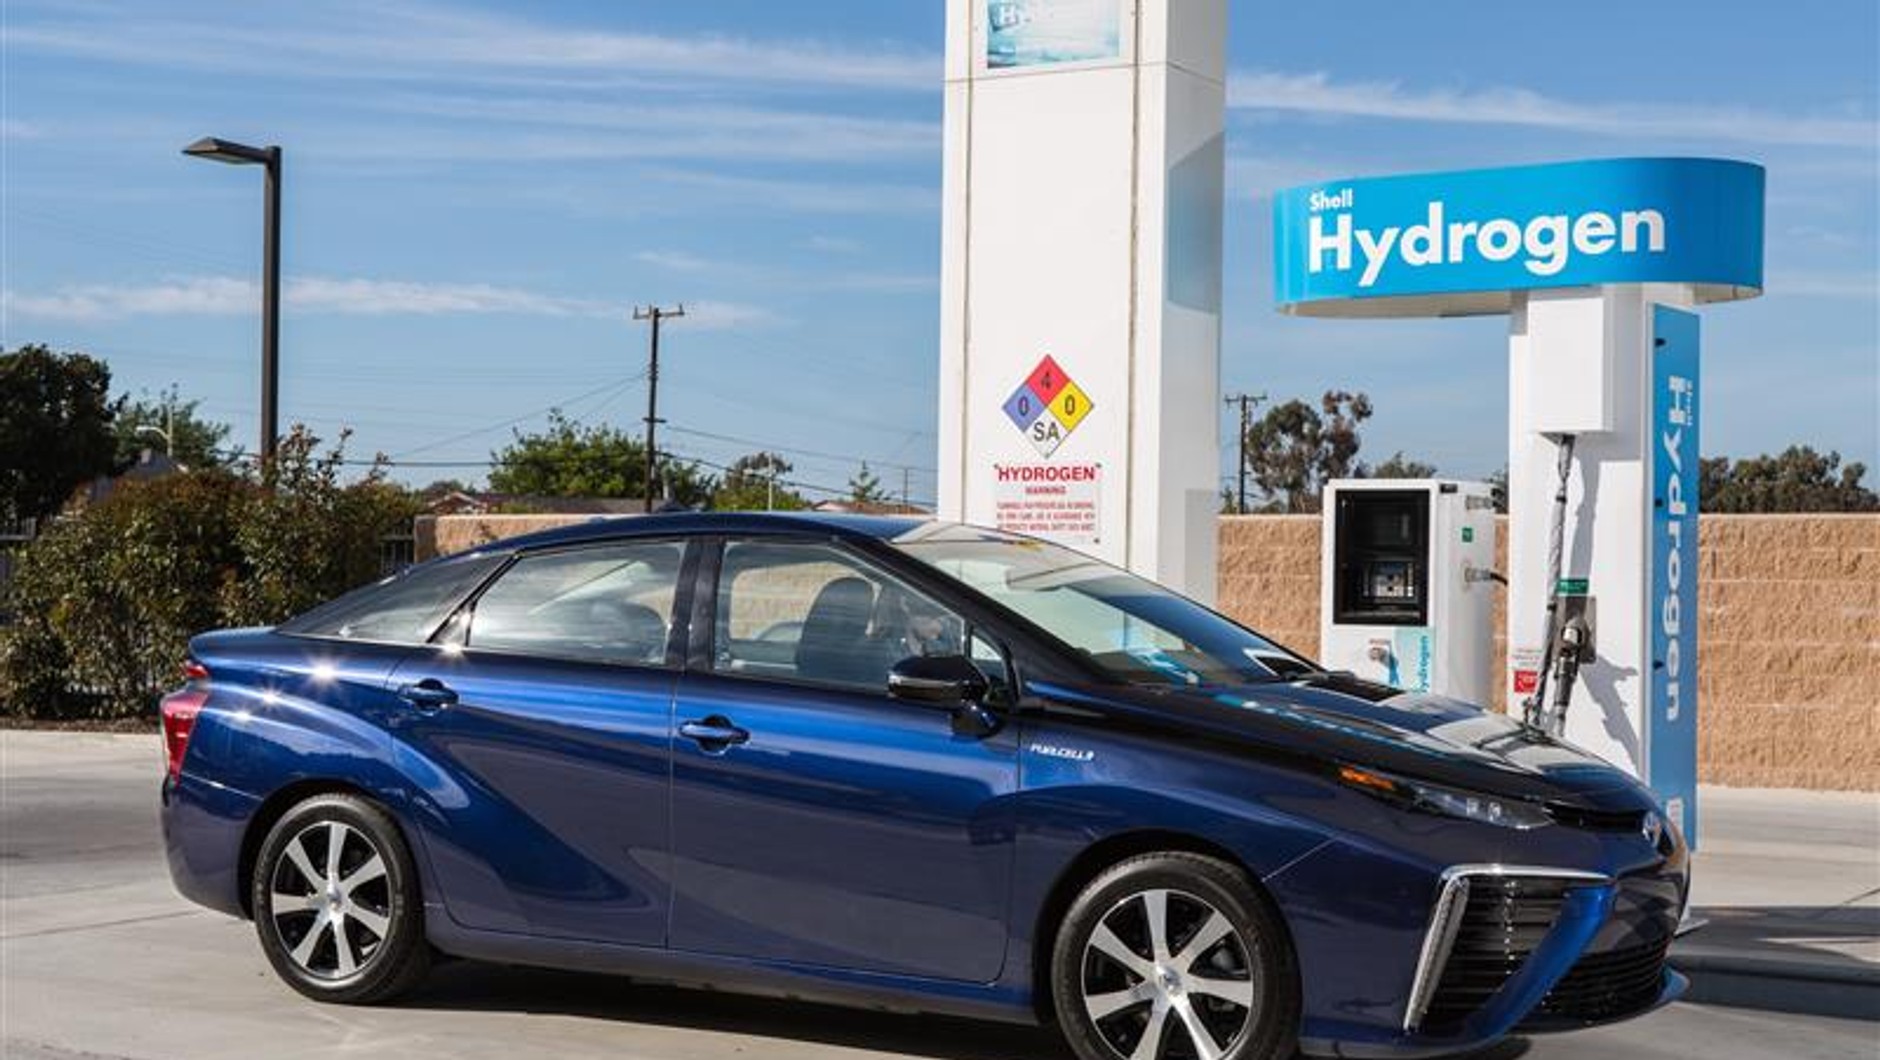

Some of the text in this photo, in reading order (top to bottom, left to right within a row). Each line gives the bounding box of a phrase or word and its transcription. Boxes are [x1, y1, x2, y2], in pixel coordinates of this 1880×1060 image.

[1309, 188, 1354, 212] Shell
[1308, 201, 1665, 287] Hydrogen
[1041, 370, 1052, 390] 4
[1018, 396, 1029, 416] 0
[1064, 394, 1075, 416] 0
[1033, 421, 1060, 442] SA
[998, 466, 1095, 481] HYDROGEN
[1663, 375, 1687, 722] Hydrogen
